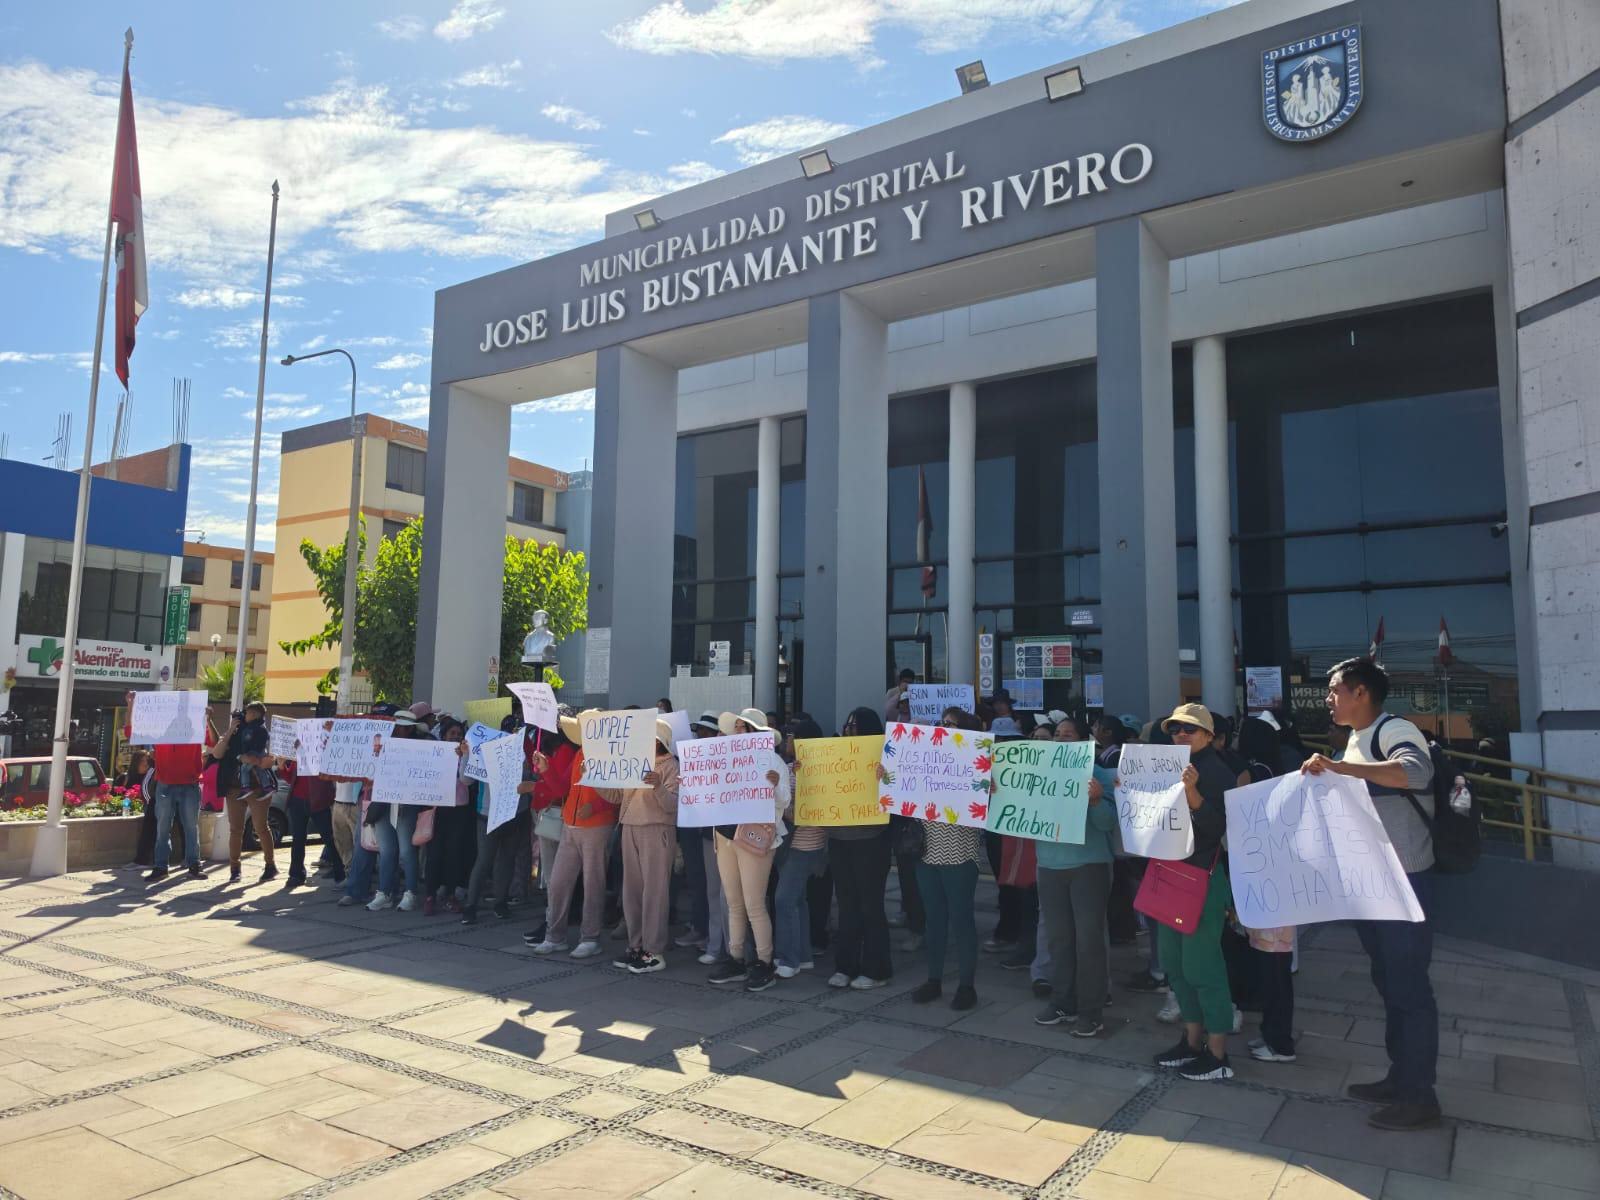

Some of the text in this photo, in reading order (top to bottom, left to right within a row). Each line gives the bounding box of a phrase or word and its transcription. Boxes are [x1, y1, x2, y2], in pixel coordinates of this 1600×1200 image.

[1269, 28, 1351, 60] DISTRITO
[580, 150, 967, 288] MUNICIPALIDAD DISTRITAL
[479, 142, 1155, 354] JOSE LUIS BUSTAMANTE Y RIVERO
[168, 595, 179, 644] BOTICA
[178, 589, 190, 641] BOTICA
[74, 650, 152, 670] AkemiFarma
[96, 645, 124, 654] BOTICA
[73, 667, 108, 677] ensando
[130, 671, 150, 679] salud
[586, 715, 633, 740] CUMPLE
[329, 747, 363, 760] NO EN
[608, 741, 626, 756] TU
[683, 737, 775, 760] USE SUS RECURSOS
[1050, 745, 1092, 769] Alcalde
[586, 757, 652, 781] PALABRA
[683, 755, 755, 772] INTERNOS PARA
[942, 765, 974, 778] AULAS
[1121, 757, 1145, 776] CUNA
[680, 770, 758, 787] CUMPLIR CON LO
[901, 777, 917, 792] NO
[681, 794, 701, 806] QUE
[704, 793, 716, 804] SE
[1120, 801, 1182, 832] PRESENTE
[1239, 798, 1270, 838] YA
[1245, 878, 1280, 913] NO
